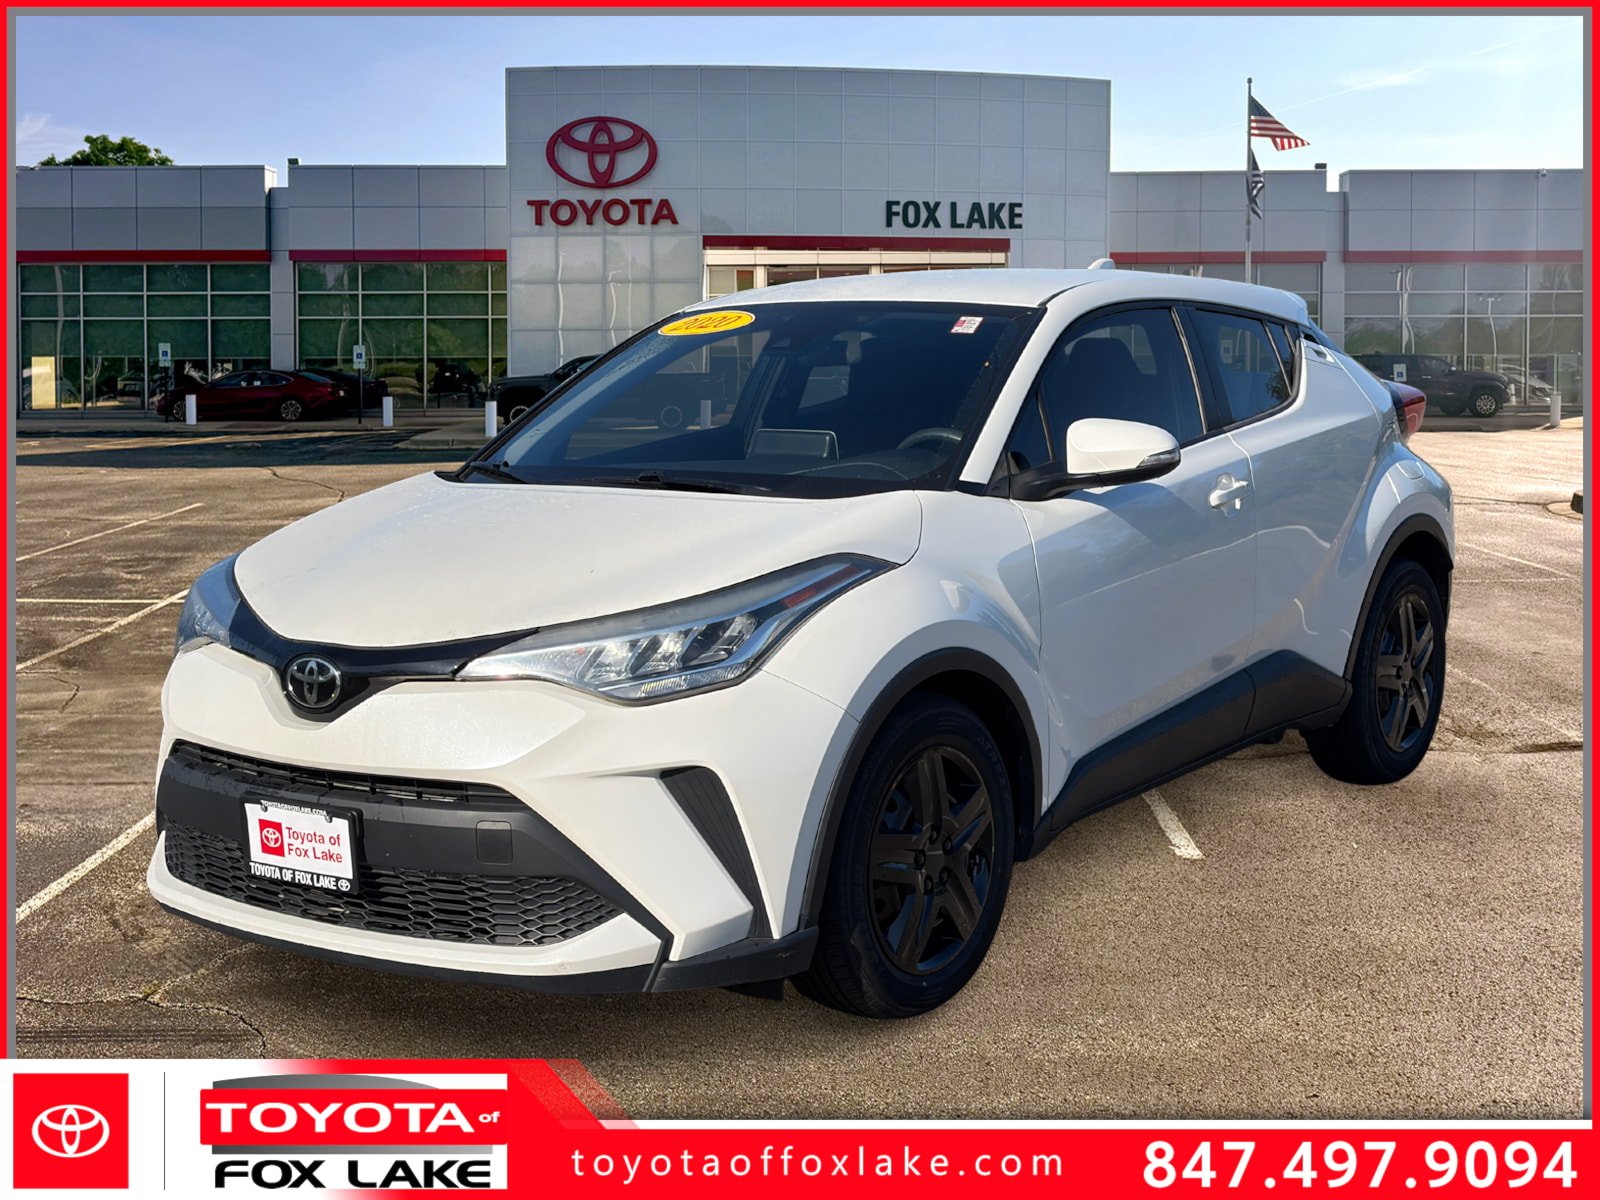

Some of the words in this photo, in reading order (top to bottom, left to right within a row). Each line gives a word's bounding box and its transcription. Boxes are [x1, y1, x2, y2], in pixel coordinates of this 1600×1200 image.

[527, 199, 679, 226] TOYOTA
[885, 201, 941, 228] FOX
[951, 201, 1023, 229] LAKE
[668, 315, 743, 331] 2020
[285, 826, 325, 845] Toyota
[328, 834, 341, 847] of
[287, 843, 310, 859] Fox
[313, 847, 343, 863] Lake
[249, 862, 281, 880] TOYOTA
[282, 868, 294, 882] OF
[295, 871, 312, 886] FOX
[313, 874, 337, 890] LAKE
